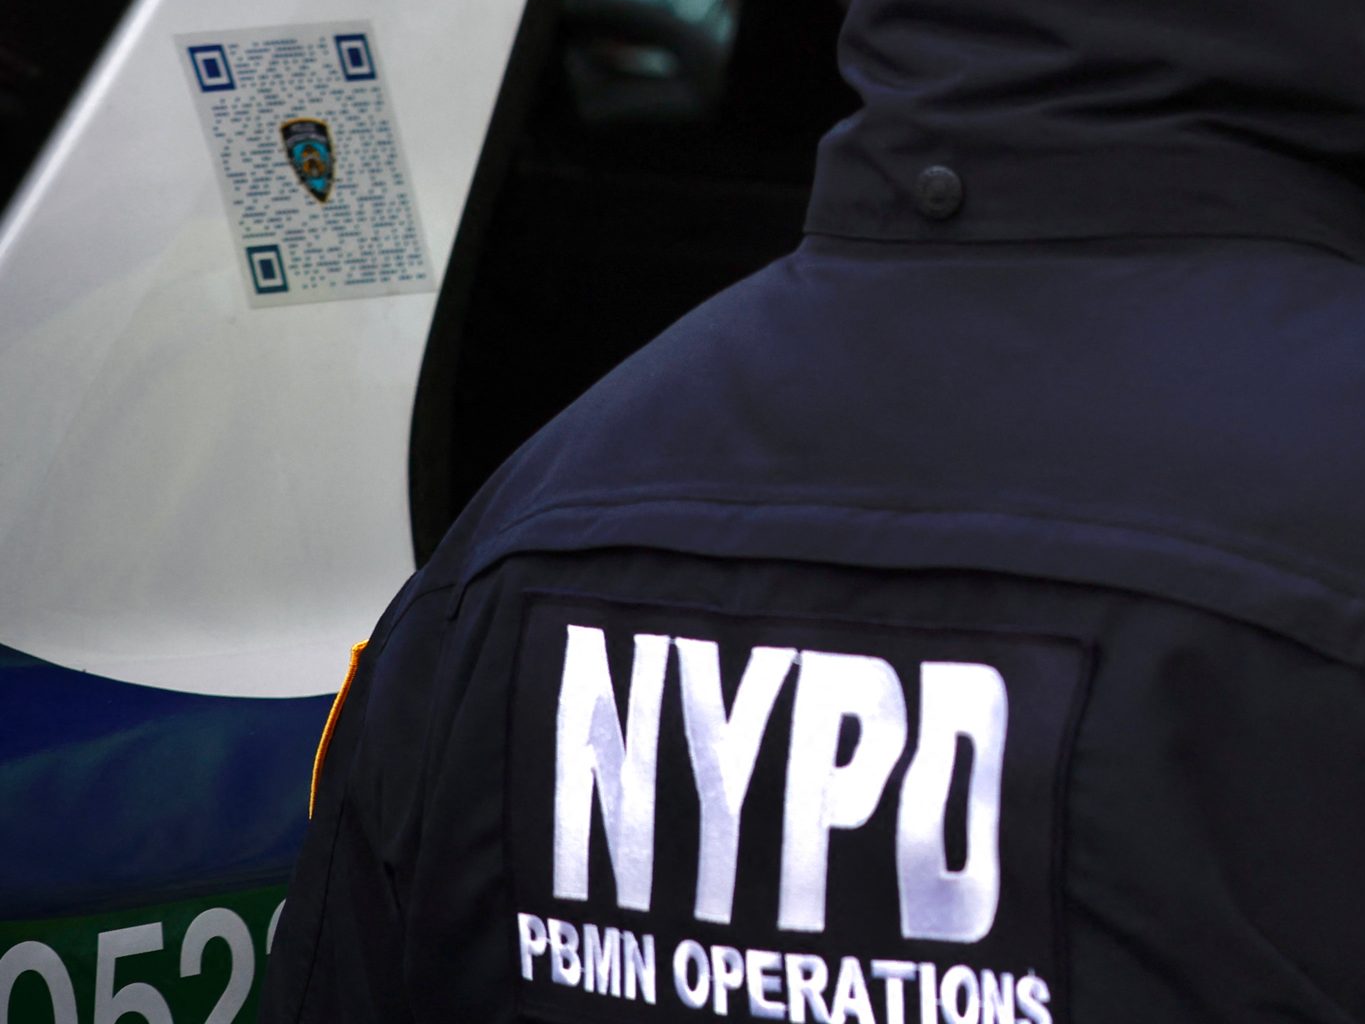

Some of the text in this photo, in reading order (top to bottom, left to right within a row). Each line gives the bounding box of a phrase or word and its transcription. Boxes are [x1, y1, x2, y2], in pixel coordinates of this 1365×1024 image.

[552, 624, 1009, 944] NYPD
[0, 898, 287, 1024] 052
[517, 912, 1053, 1024] PBMN OPERATIONS
